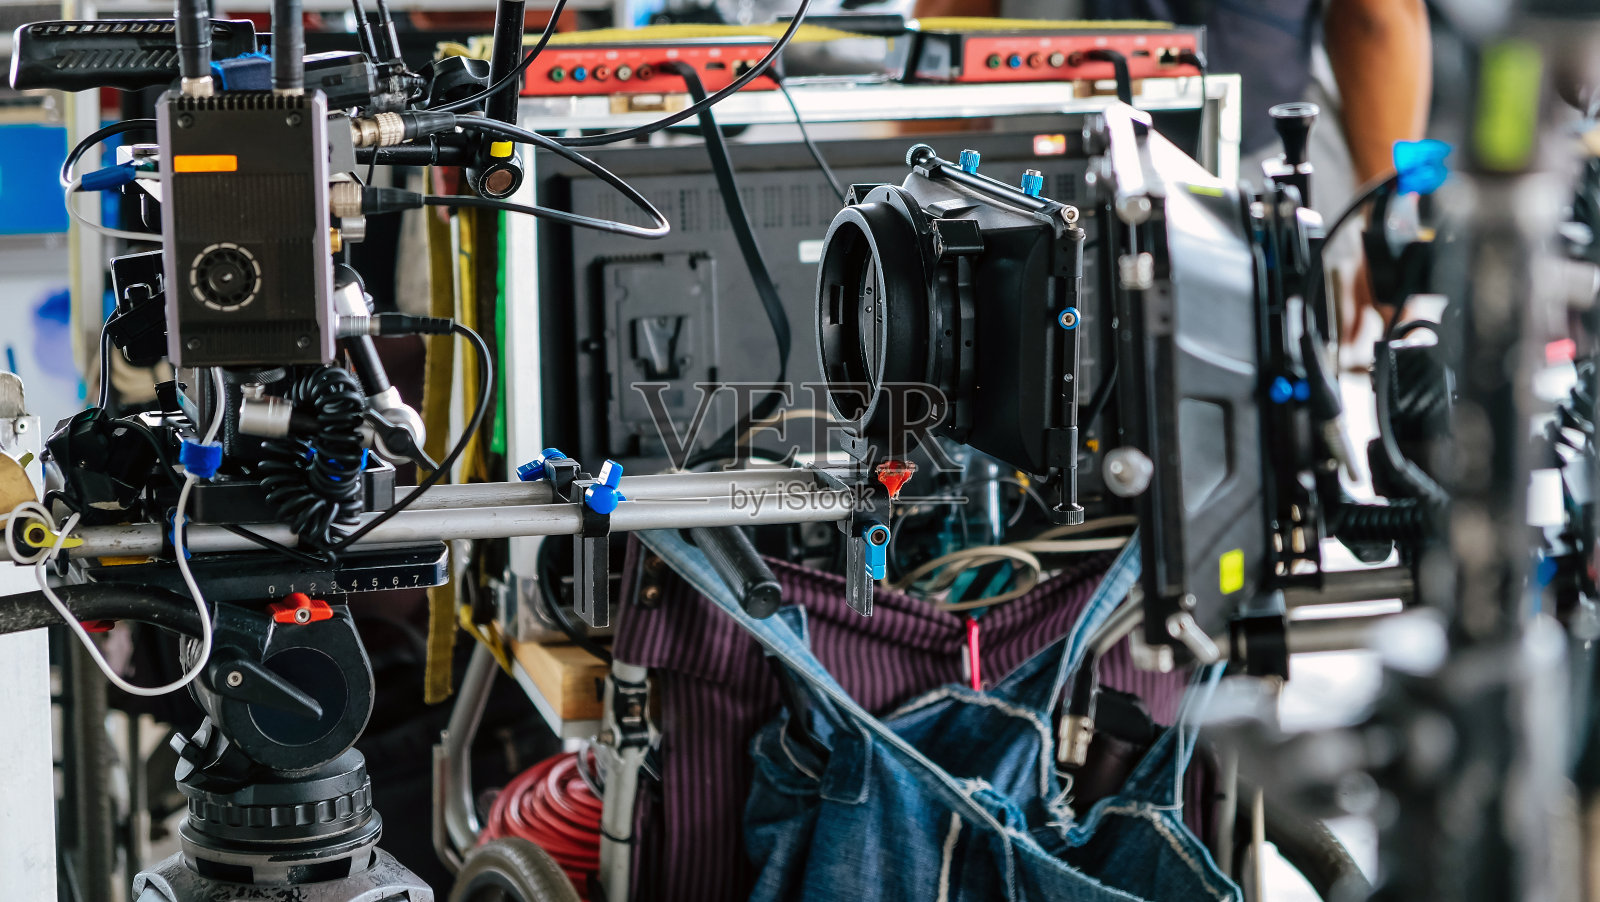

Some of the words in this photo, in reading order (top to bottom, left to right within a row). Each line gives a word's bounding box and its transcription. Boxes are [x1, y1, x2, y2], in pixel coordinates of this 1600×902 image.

[268, 585, 275, 594] 0
[289, 584, 294, 592] 1
[310, 582, 316, 591] 2
[330, 581, 337, 590] 3
[352, 580, 358, 588] 4
[372, 578, 378, 586] 5
[392, 576, 399, 585] 6
[412, 575, 420, 584] 7
